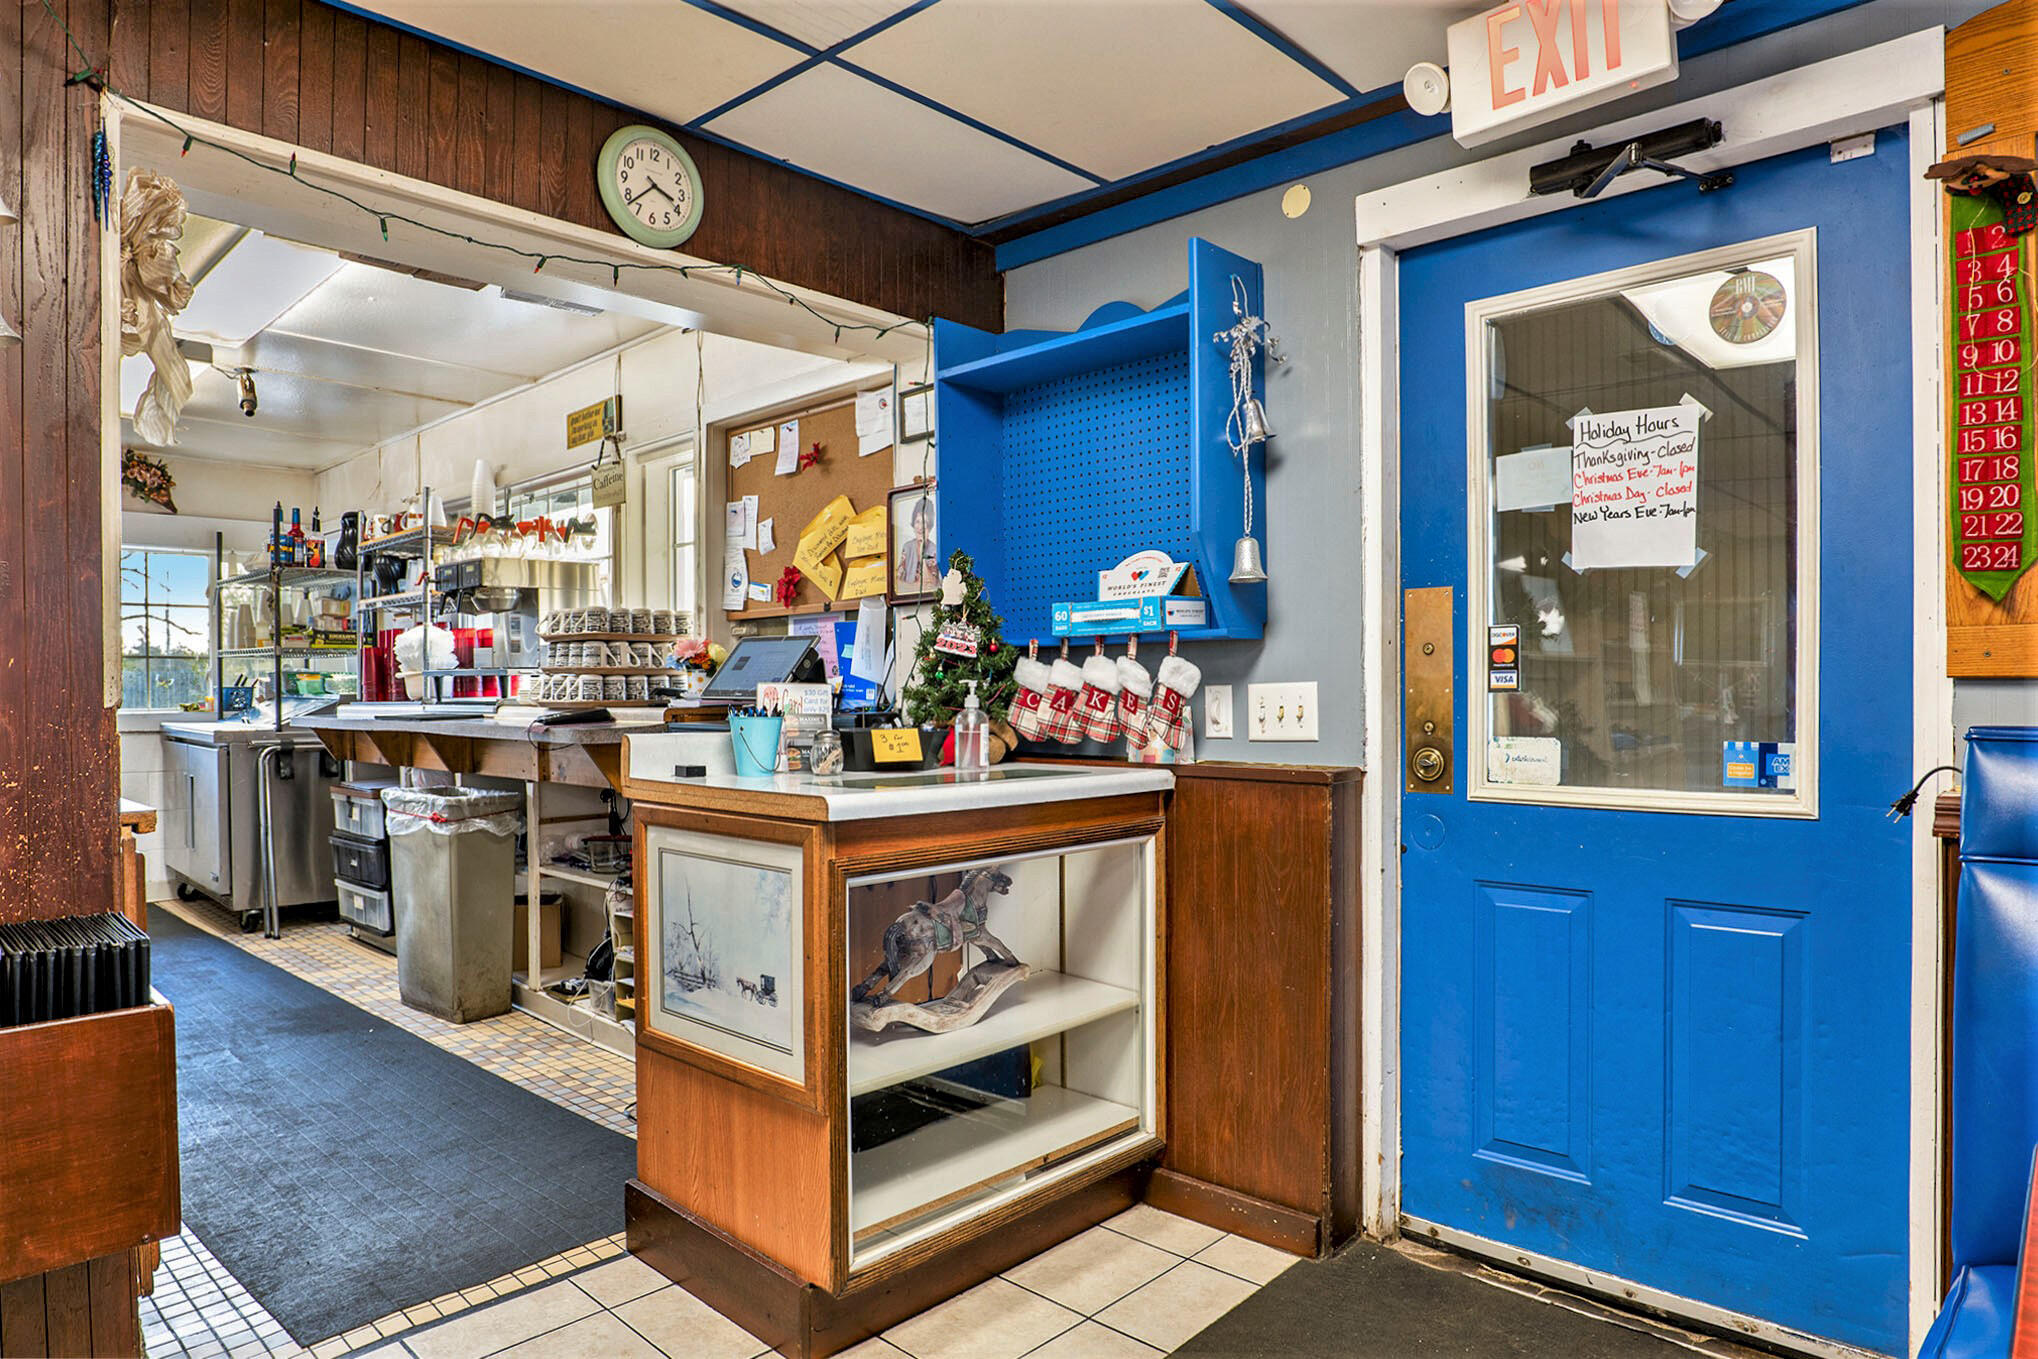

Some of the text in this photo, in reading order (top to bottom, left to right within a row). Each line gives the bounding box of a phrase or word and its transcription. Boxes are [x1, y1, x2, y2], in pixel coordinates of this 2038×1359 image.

[623, 155, 634, 169] 10
[636, 147, 644, 161] 11
[650, 148, 660, 162] 12
[620, 170, 628, 183] 9
[674, 172, 682, 185] 2
[624, 187, 632, 201] 8
[678, 189, 686, 202] 3
[635, 202, 642, 215] 7
[674, 204, 681, 216] 4
[648, 212, 656, 225] 6
[663, 212, 671, 225] 5
[1964, 225, 2006, 254] 1 2
[1967, 254, 2017, 283] 3 4
[1968, 280, 2013, 309] 5 6
[1966, 309, 2014, 336] 7 8
[1962, 339, 2015, 367] 9 10
[1964, 369, 2018, 396] 11 12
[1963, 398, 2018, 425] 13 14
[1580, 413, 1679, 444] Holiday Hours
[1962, 425, 2017, 453] 15 16
[1962, 455, 2019, 481] 17 18
[1573, 471, 1624, 489] Christmas
[1572, 490, 1622, 508] Christmas
[1656, 480, 1692, 497] Closed
[1960, 484, 2019, 510] 19 20
[1573, 509, 1598, 524] New
[1599, 505, 1631, 521] Years
[1964, 512, 2023, 536] 21 22
[1964, 545, 2019, 568] 23 24
[1054, 611, 1068, 621] 60
[1143, 605, 1154, 617] $1
[935, 638, 977, 655] 2023
[1495, 675, 1514, 684] VISA
[880, 734, 888, 743] 3
